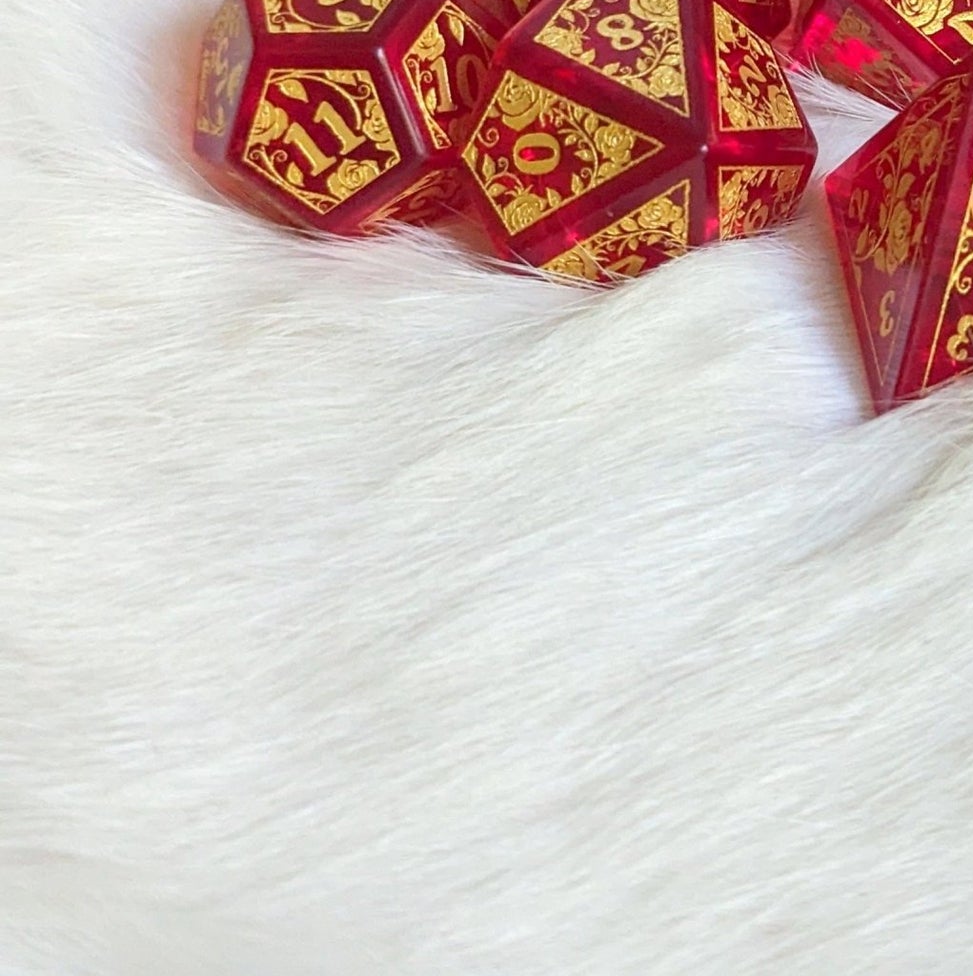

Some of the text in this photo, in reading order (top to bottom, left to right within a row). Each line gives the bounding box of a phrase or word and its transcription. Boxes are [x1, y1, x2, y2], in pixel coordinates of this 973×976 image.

[597, 13, 645, 50] 8
[430, 55, 487, 112] 10
[284, 101, 366, 176] 11
[513, 133, 561, 175] 0
[878, 289, 896, 338] 3
